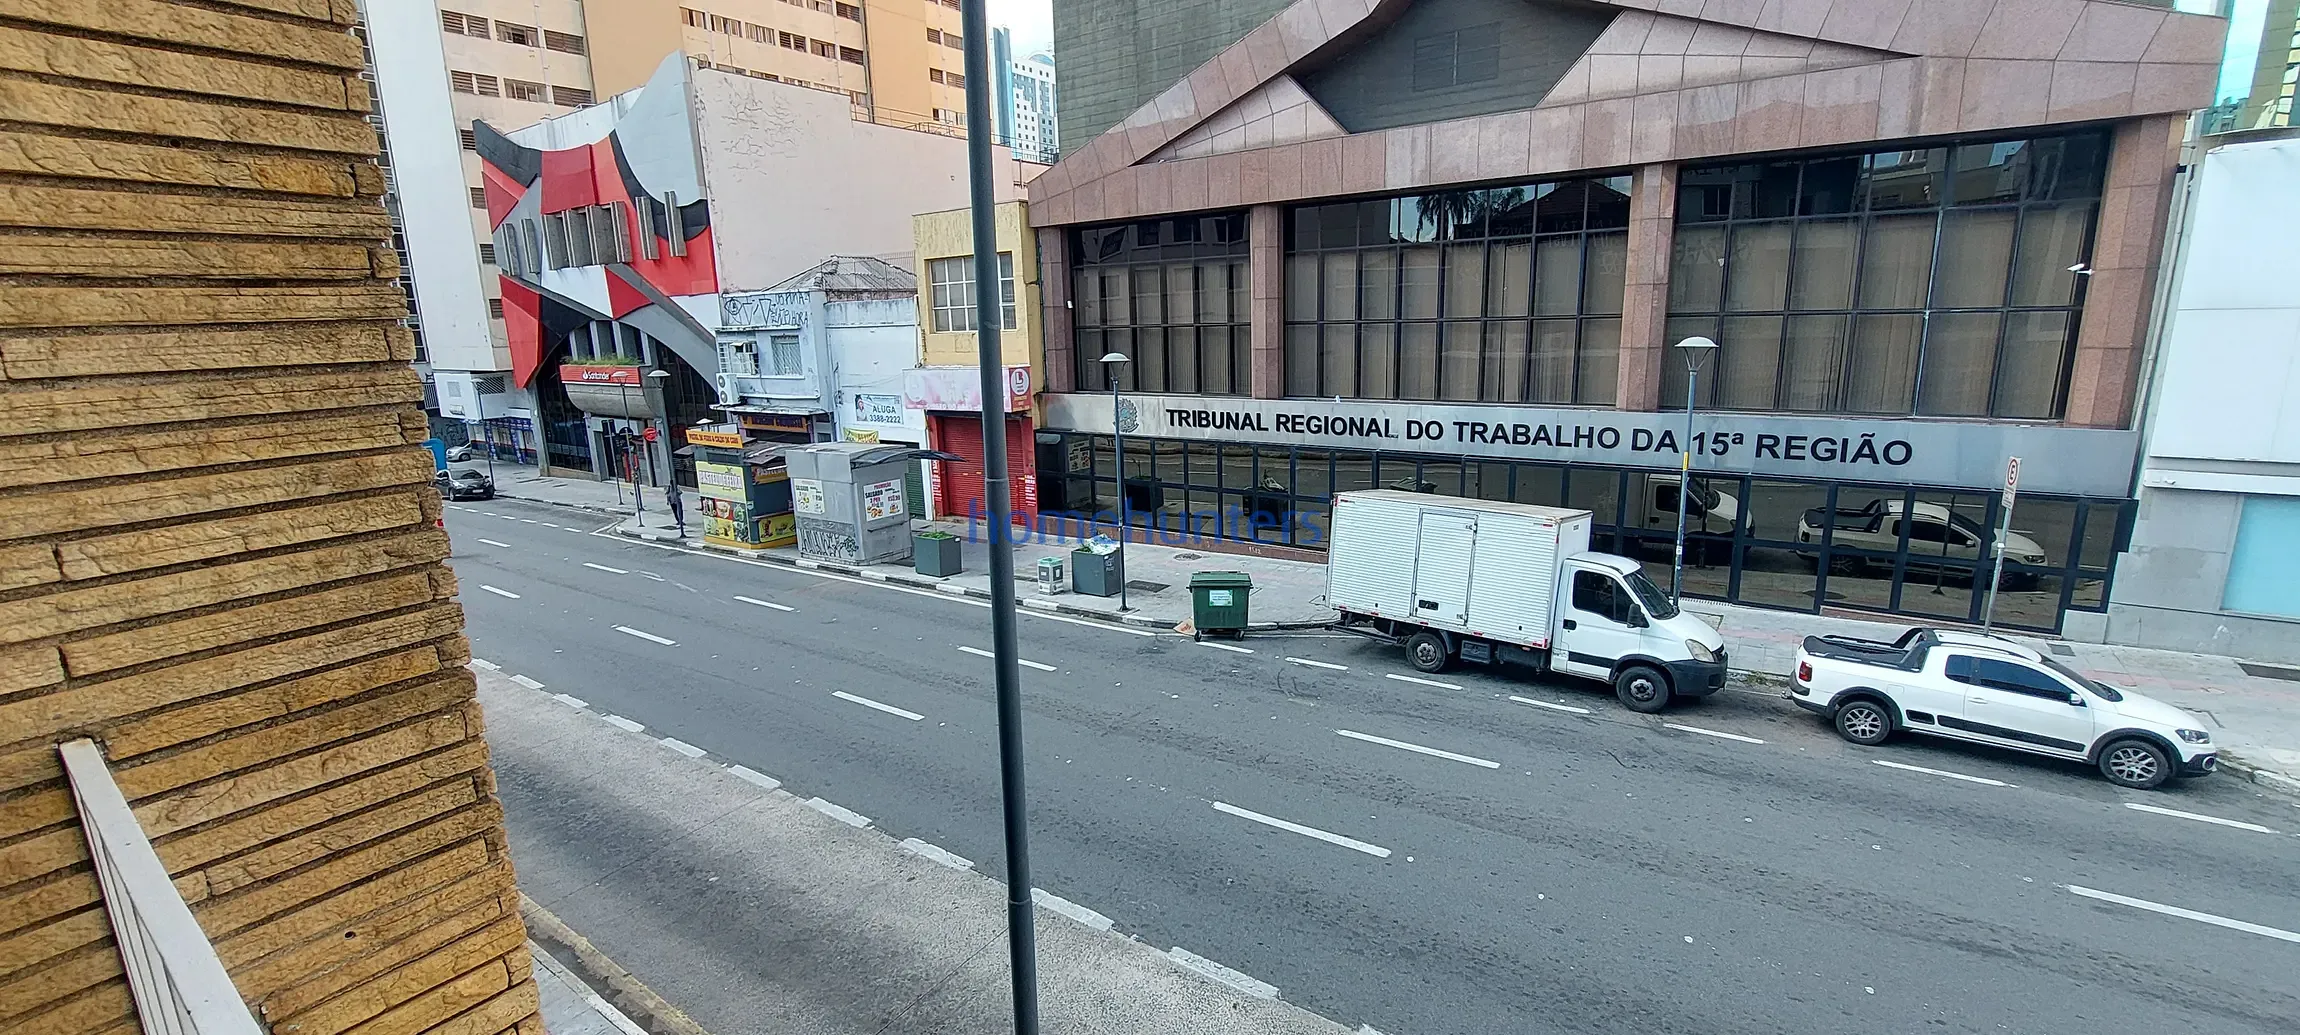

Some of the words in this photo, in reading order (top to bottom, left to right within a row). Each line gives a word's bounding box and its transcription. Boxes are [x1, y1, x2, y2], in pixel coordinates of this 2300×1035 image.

[588, 371, 610, 381] Santander
[872, 405, 897, 414] ALUGA
[869, 414, 901, 424] 3388-2222
[1165, 408, 1269, 432] TRIBUNAL
[1275, 414, 1391, 438] REGIONAL
[1406, 420, 1444, 441] DO
[1453, 421, 1620, 450] TRABALHO
[1631, 428, 1680, 453] DA
[1692, 431, 1744, 456] 15ª
[1755, 432, 1913, 466] REGIÃO
